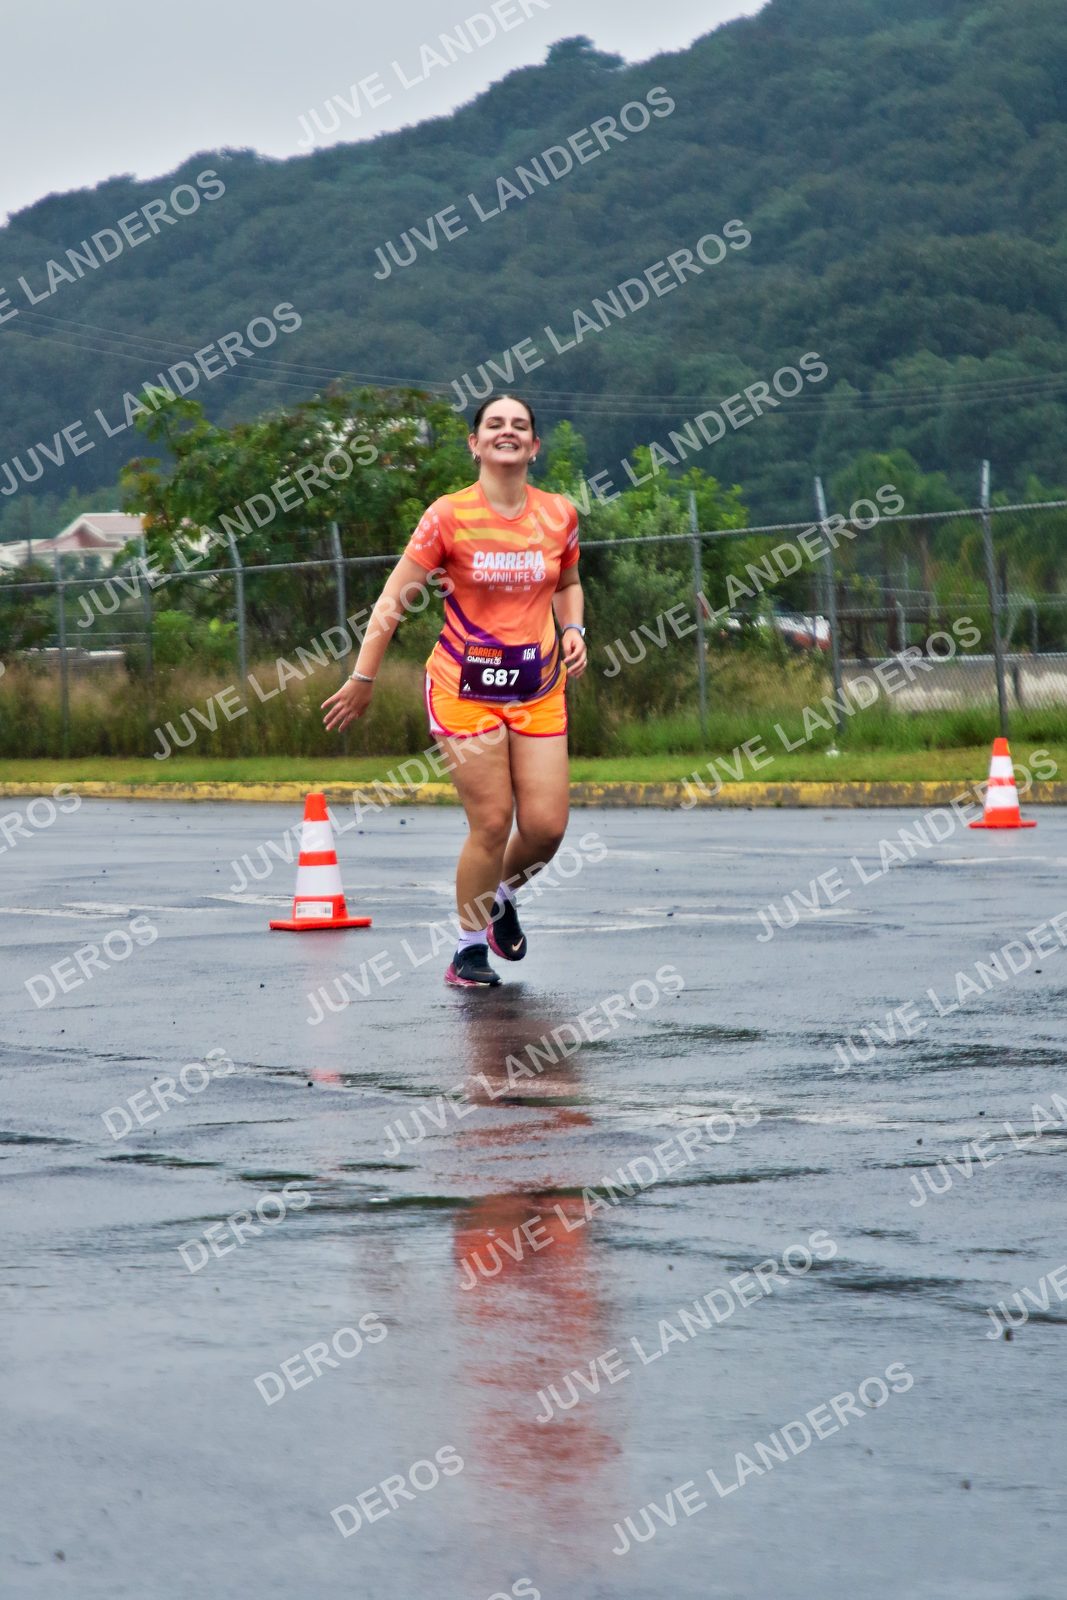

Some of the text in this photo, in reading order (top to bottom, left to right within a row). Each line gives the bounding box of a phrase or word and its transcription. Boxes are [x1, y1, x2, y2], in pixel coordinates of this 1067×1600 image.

[473, 550, 545, 570] CARRERA
[473, 570, 530, 583] OMNILIFE
[468, 646, 503, 657] CARRERA
[482, 668, 520, 687] 687
